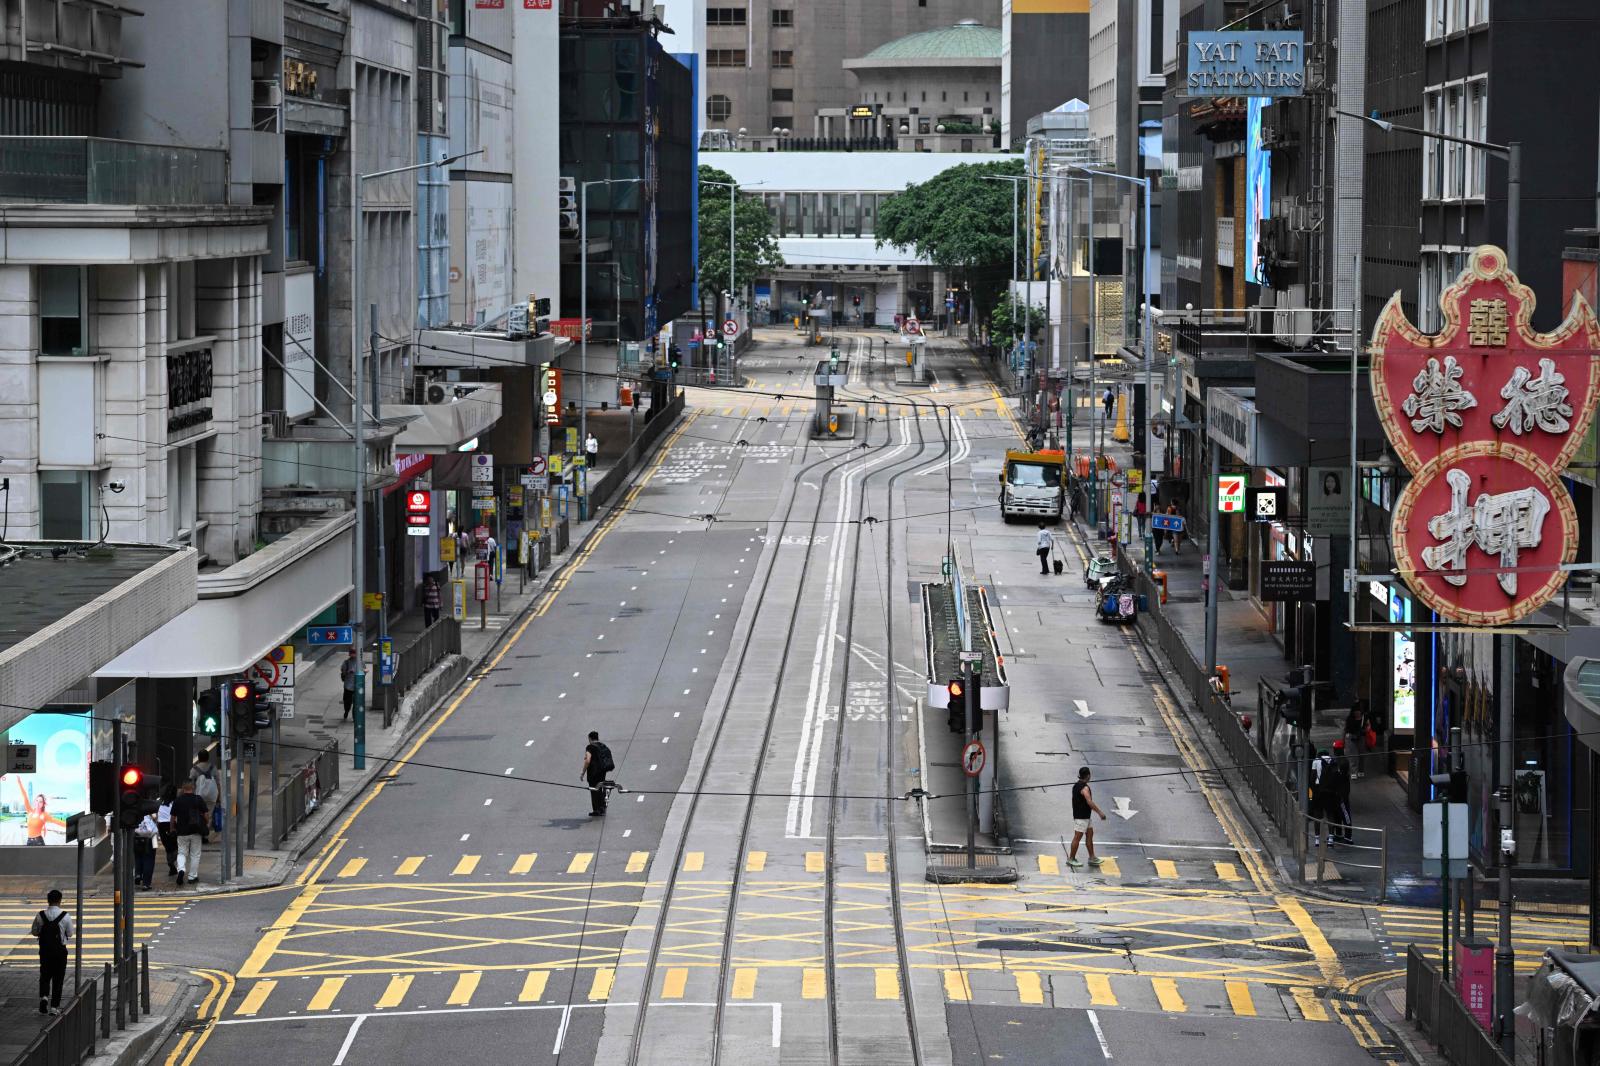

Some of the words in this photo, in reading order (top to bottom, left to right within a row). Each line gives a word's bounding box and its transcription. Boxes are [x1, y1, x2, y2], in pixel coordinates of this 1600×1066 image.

[1194, 41, 1242, 63] YAT
[1255, 41, 1298, 63] FAT
[1188, 71, 1304, 88] STATIONERS
[1421, 468, 1550, 596] 押
[282, 665, 288, 673] 7
